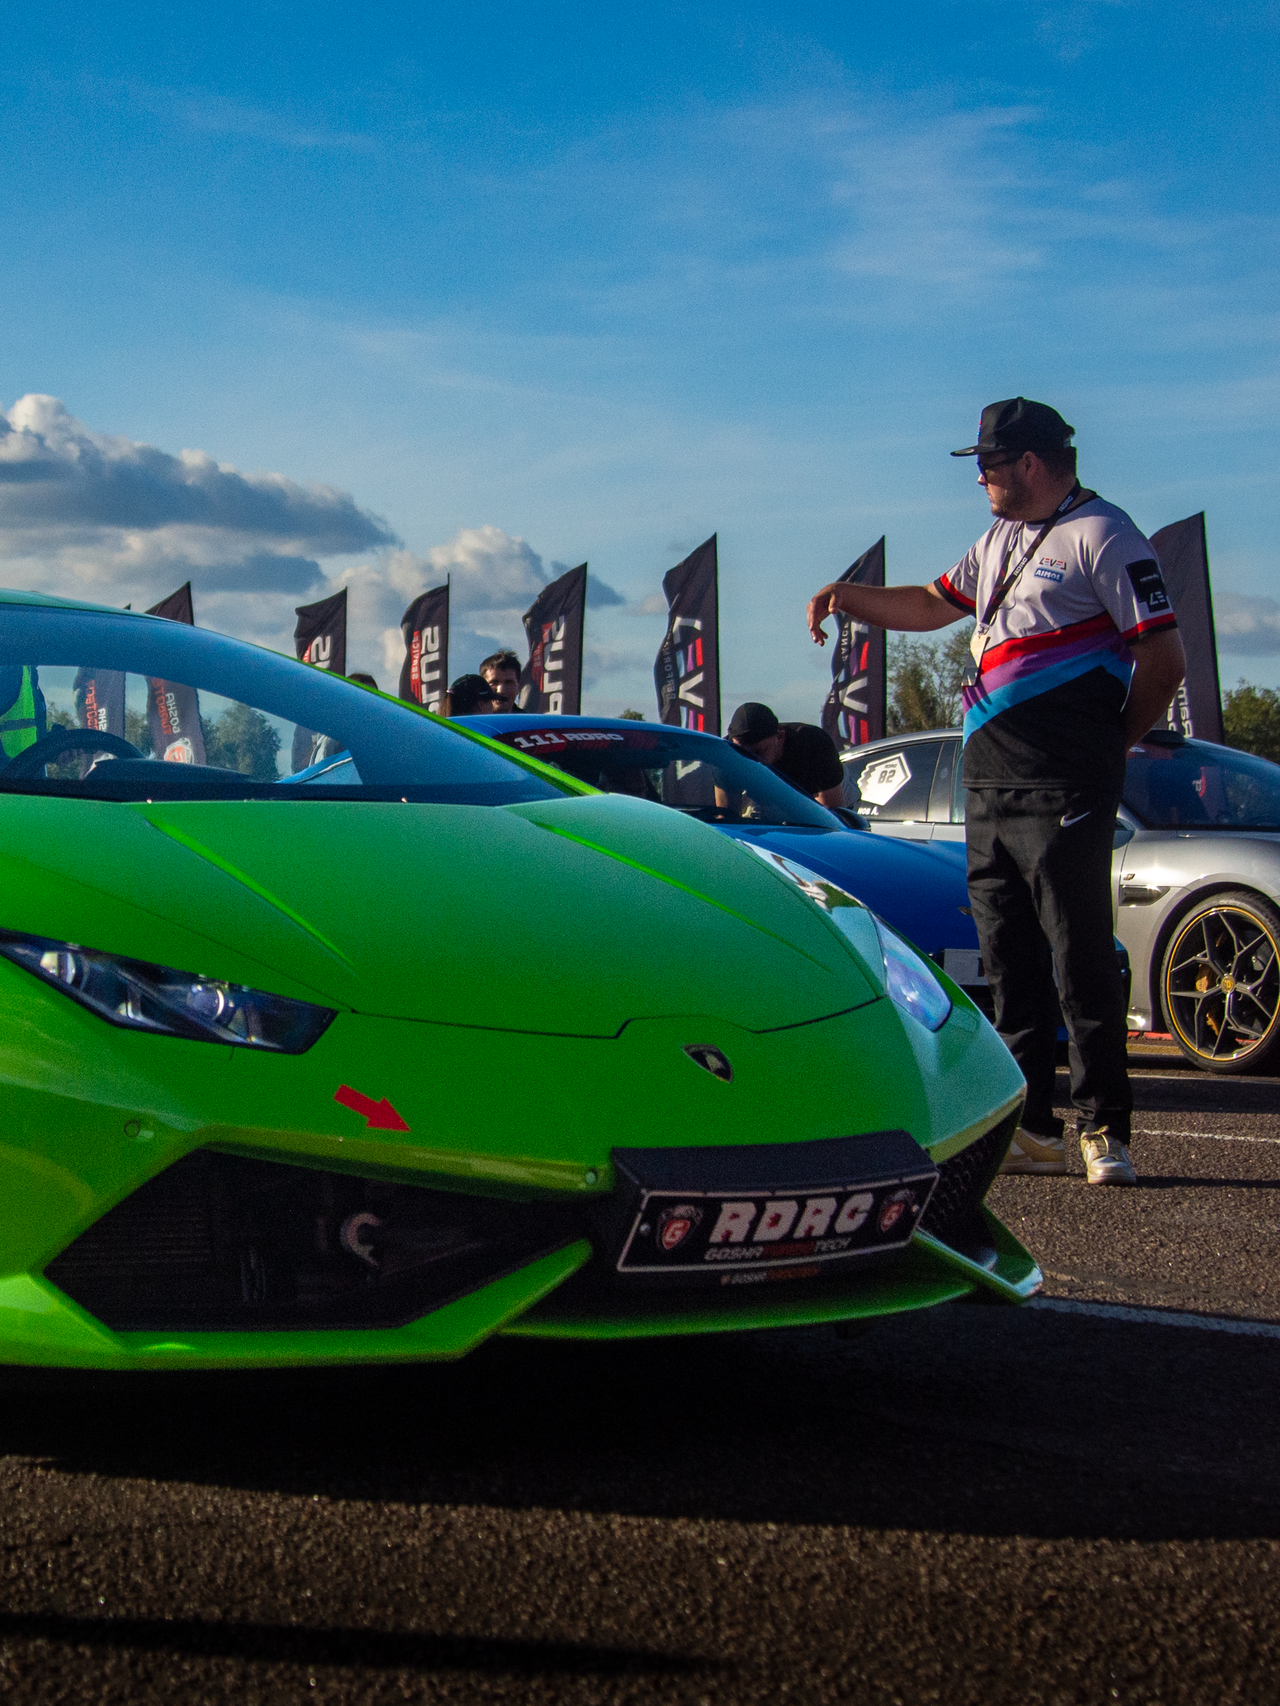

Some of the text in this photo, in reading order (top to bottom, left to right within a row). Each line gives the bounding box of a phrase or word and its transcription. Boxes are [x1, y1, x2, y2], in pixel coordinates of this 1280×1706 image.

[514, 733, 565, 749] 111
[877, 769, 896, 784] 82
[709, 1192, 874, 1243] RDRC
